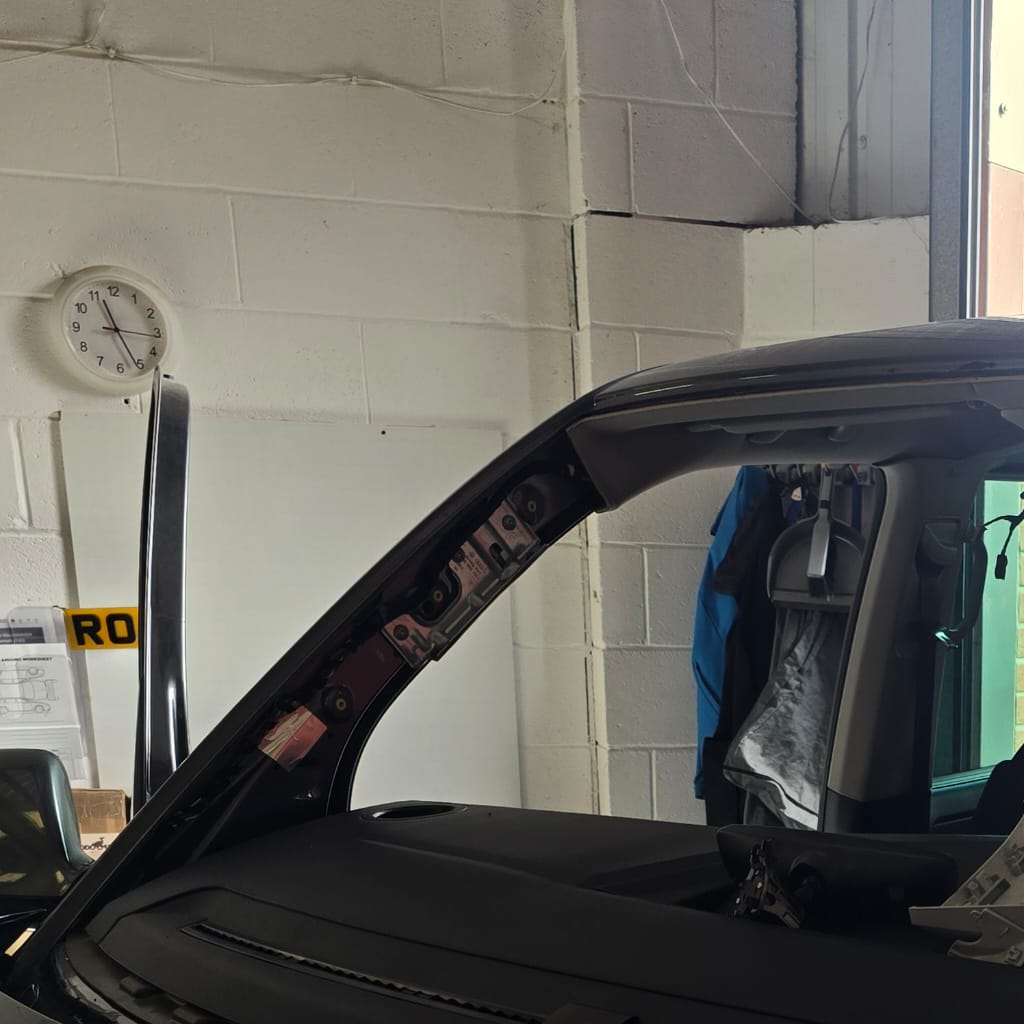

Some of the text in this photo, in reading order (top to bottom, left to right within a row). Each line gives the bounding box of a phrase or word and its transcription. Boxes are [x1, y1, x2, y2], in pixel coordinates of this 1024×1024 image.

[88, 291, 99, 301] 11
[107, 286, 120, 297] 12
[131, 293, 137, 304] 1
[75, 302, 87, 314] 10
[146, 308, 155, 319] 2
[72, 321, 80, 332] 9
[153, 328, 161, 338] 3
[80, 341, 88, 352] 8
[149, 347, 157, 357] 4
[96, 355, 104, 366] 7
[136, 359, 144, 369] 5
[116, 363, 124, 374] 6
[72, 613, 136, 646] RO
